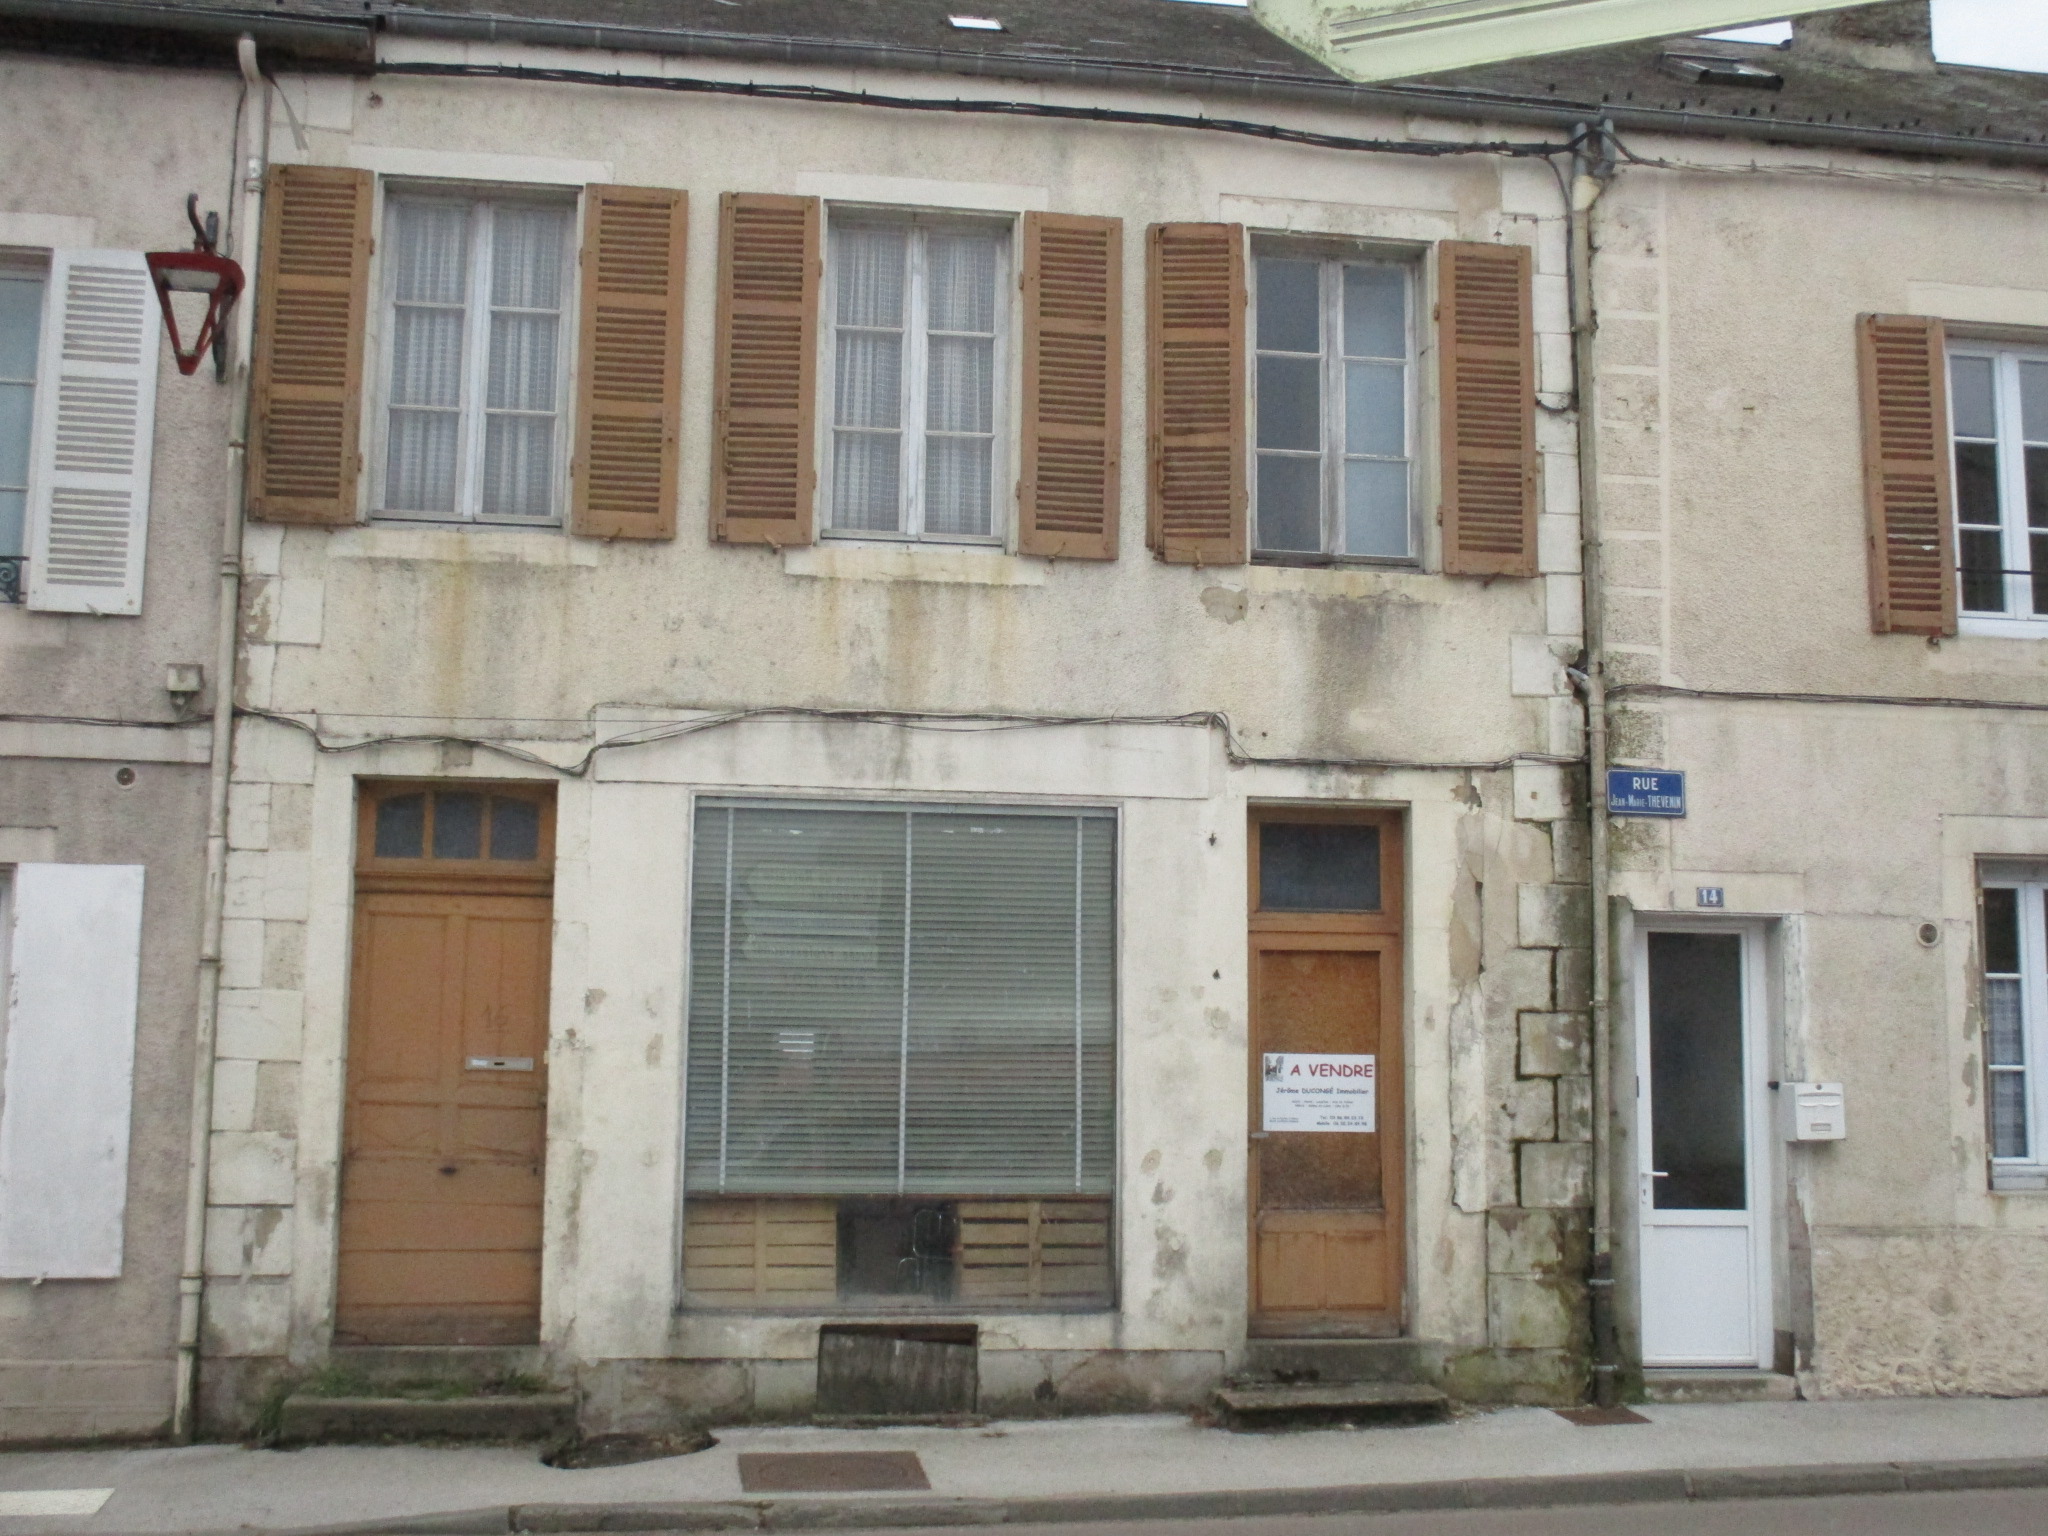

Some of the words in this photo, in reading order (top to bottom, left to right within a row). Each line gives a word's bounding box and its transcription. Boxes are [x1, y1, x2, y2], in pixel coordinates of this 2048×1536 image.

[1633, 777, 1659, 791] RUE
[1702, 889, 1718, 904] 14
[1290, 1064, 1301, 1076] A
[1308, 1063, 1374, 1078] VENDRE
[1336, 1087, 1369, 1095] Immobilier
